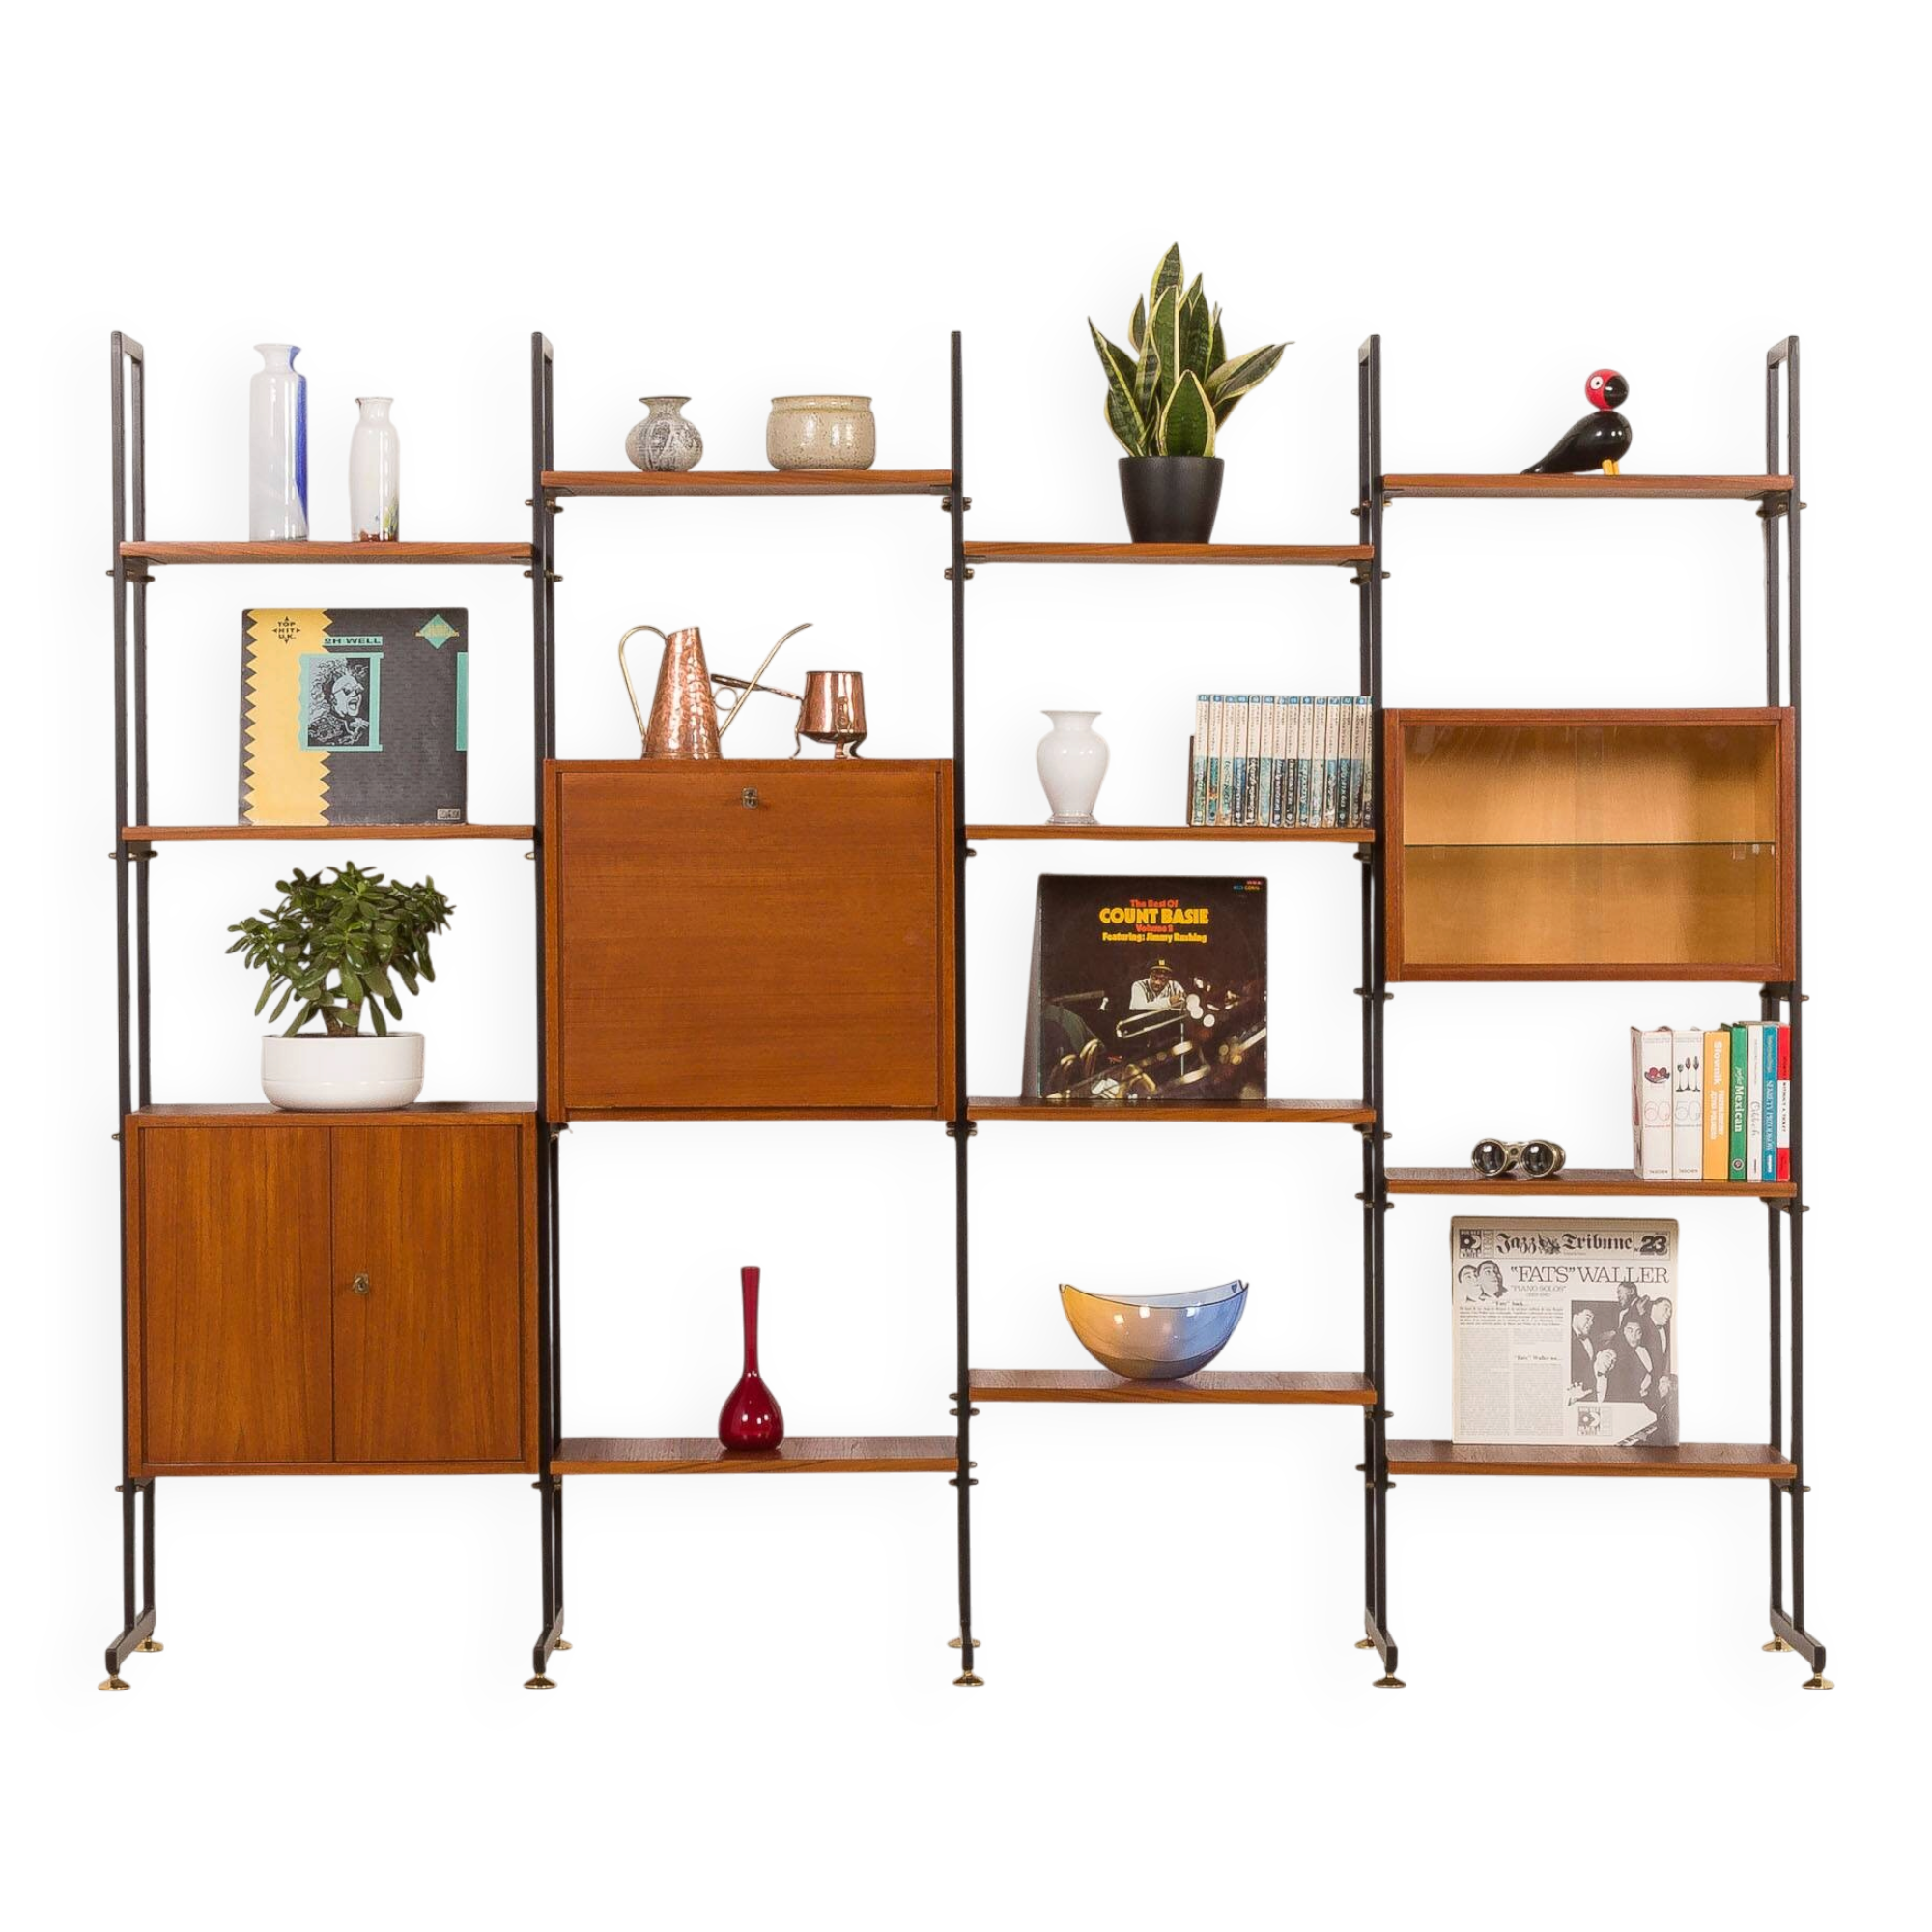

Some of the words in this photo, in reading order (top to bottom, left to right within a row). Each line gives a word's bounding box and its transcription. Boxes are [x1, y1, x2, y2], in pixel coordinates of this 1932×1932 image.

[1130, 899, 1146, 908] The
[1099, 907, 1159, 923] COUNT
[1160, 908, 1209, 924] BASIE
[1102, 932, 1146, 943] Featuring:
[1146, 932, 1173, 944] Jimmy
[1174, 933, 1208, 944] Rushing
[1734, 1084, 1745, 1133] Mexican
[1496, 1233, 1537, 1254] Jazz
[1562, 1233, 1633, 1250] Tribune
[1640, 1236, 1667, 1256] 23
[1577, 1266, 1669, 1284] WALLER
